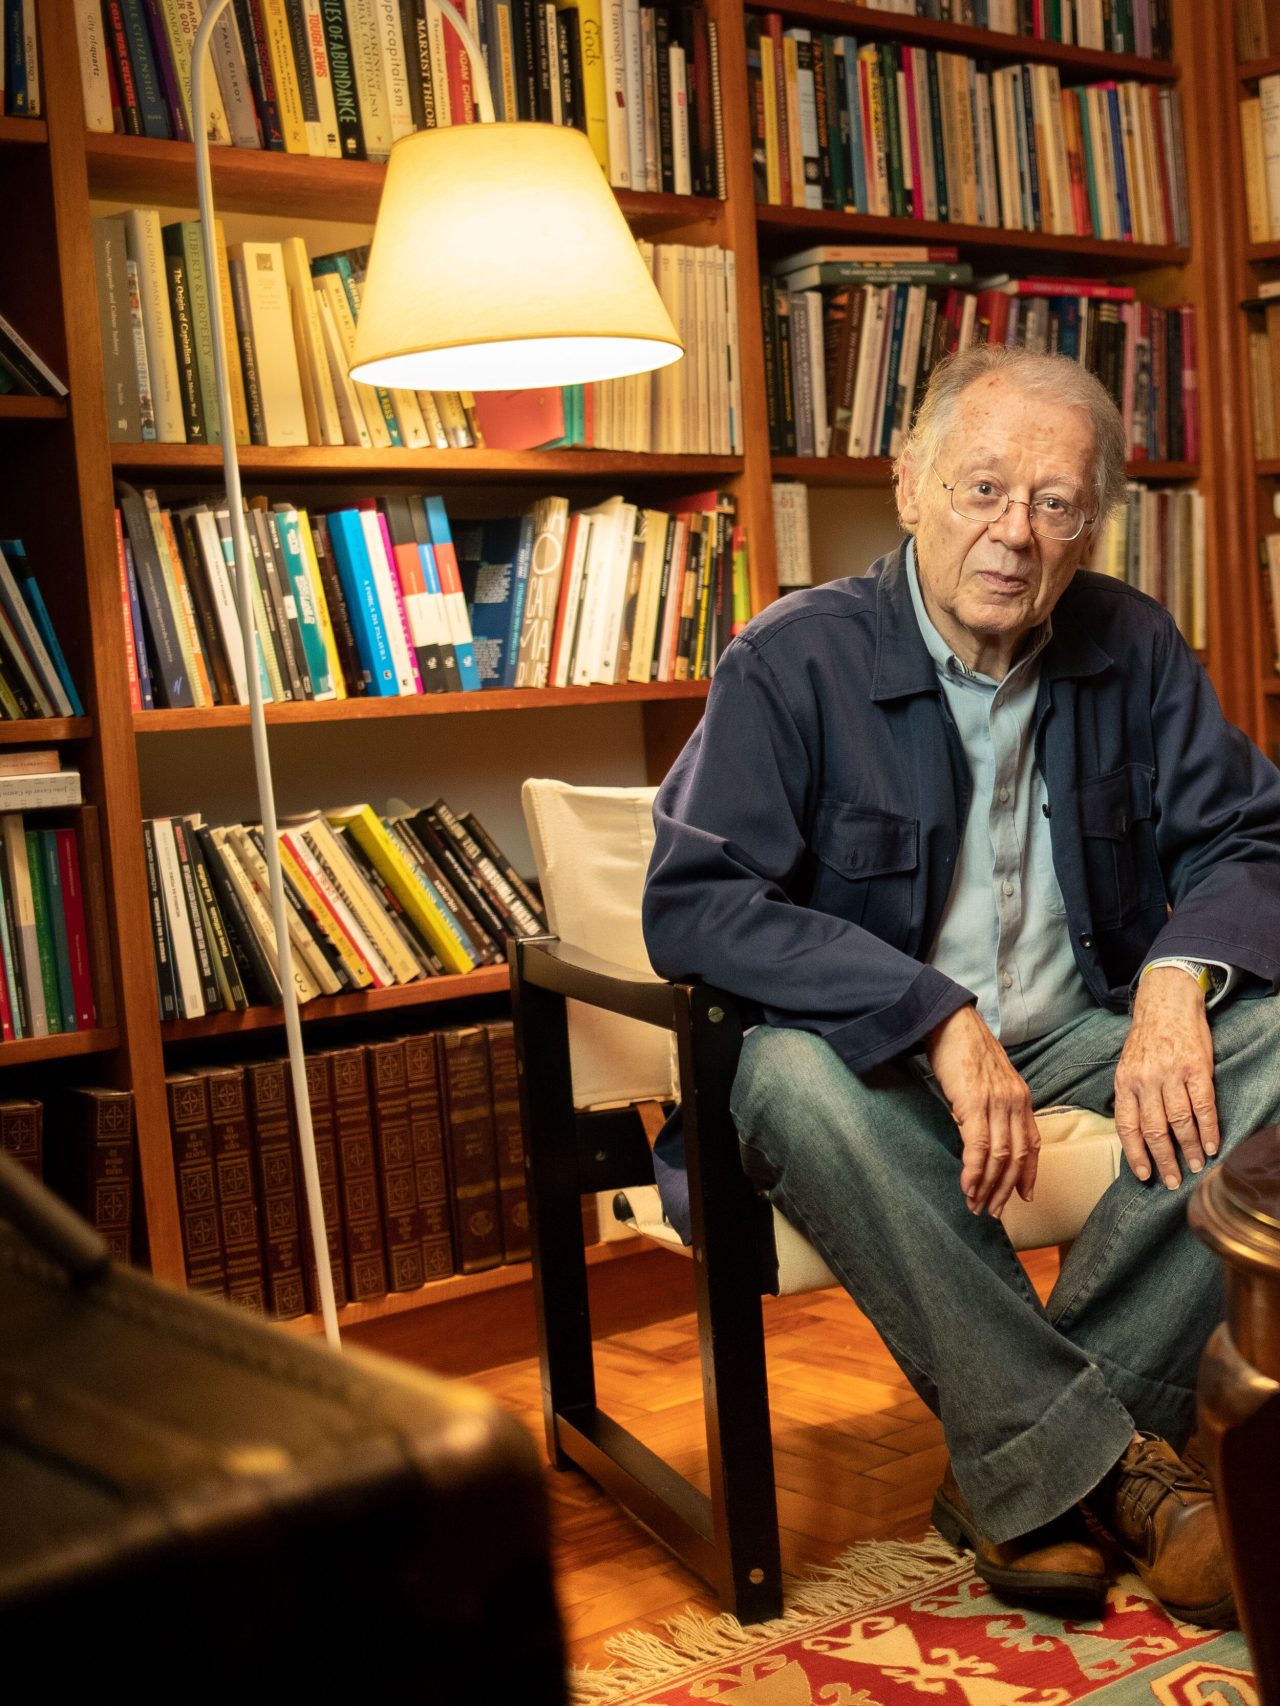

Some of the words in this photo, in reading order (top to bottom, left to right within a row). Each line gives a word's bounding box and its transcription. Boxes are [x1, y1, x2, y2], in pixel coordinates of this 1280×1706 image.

[86, 15, 98, 31] city
[110, 2, 121, 30] COLD
[166, 0, 183, 54] OMMODIFY
[180, 13, 191, 35] GOD
[308, 14, 323, 48] TOUGH
[115, 32, 127, 58] WAR
[328, 26, 343, 40] OF
[367, 21, 382, 77] MAKING
[416, 19, 432, 80] MARXIST
[582, 19, 601, 67] Gods
[609, 3, 625, 66] University
[88, 46, 100, 77] quartz
[132, 24, 156, 104] CITIZENSHIP
[221, 27, 232, 56] PAUL
[228, 62, 242, 104] GILROY
[313, 48, 328, 78] JEWS
[382, 0, 405, 107] upercapitalism
[458, 49, 470, 80] NOAM
[121, 60, 137, 108] CULTURE
[259, 43, 277, 102] SOCIALISM
[330, 41, 357, 124] ABUNDANCE
[362, 33, 379, 118] CAPITALISM
[423, 81, 436, 128] THEOR
[104, 241, 116, 291] Neo-Avantgarde
[144, 220, 153, 239] ONE
[152, 281, 160, 306] MANY
[156, 311, 165, 339] PATHS
[174, 269, 183, 284] The
[109, 292, 117, 304] and
[174, 286, 186, 312] Origin
[188, 231, 202, 283] LIBERTY
[197, 298, 213, 358] PROPERTY
[110, 305, 119, 329] Culture
[179, 313, 188, 322] of
[111, 331, 121, 356] Industry
[179, 324, 193, 365] Capitalism
[242, 337, 255, 368] EMPIRE
[247, 370, 257, 382] OF
[248, 384, 261, 417] CAPITAL
[364, 586, 376, 613] FORÇA
[370, 614, 379, 625] DA
[373, 626, 388, 661] PALAVRA
[219, 937, 230, 957] Flores
